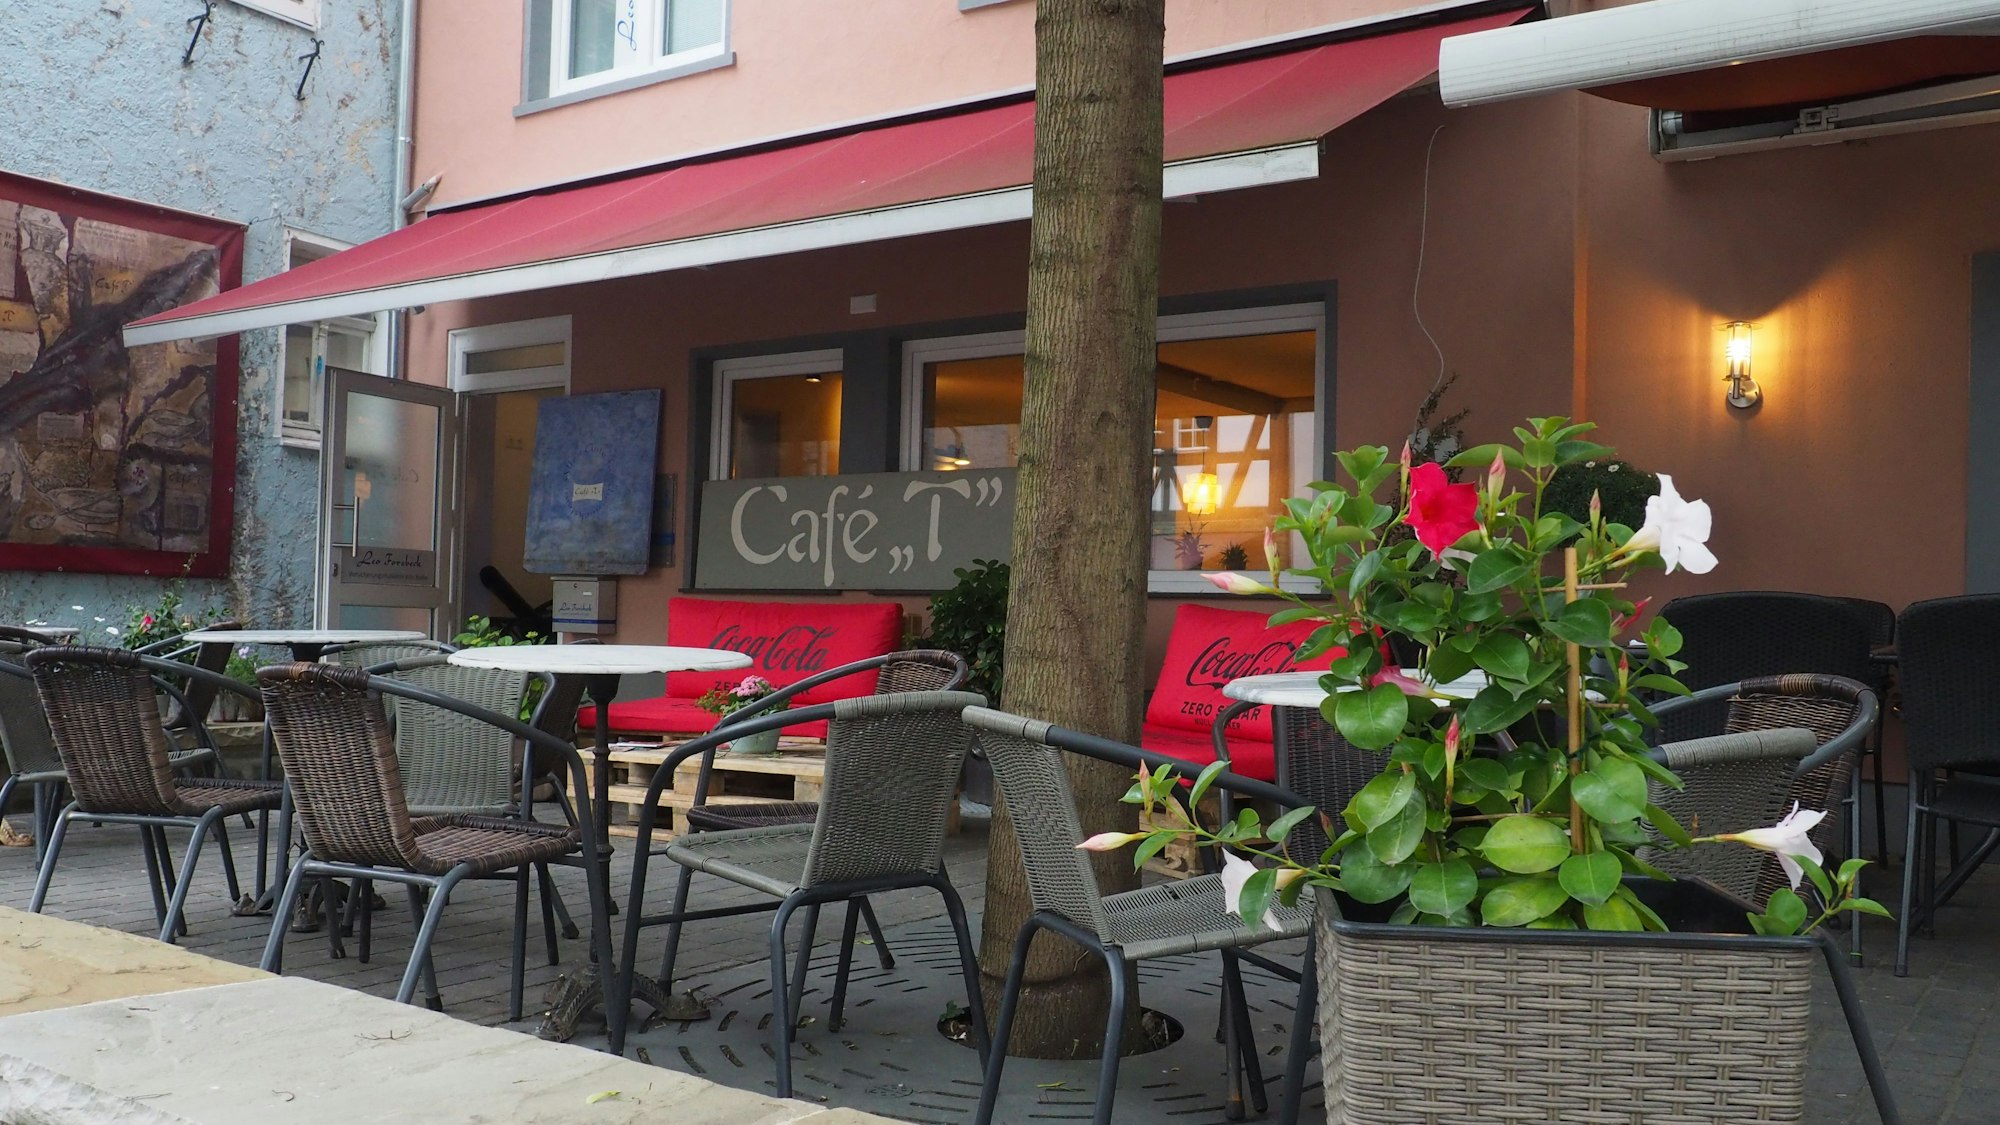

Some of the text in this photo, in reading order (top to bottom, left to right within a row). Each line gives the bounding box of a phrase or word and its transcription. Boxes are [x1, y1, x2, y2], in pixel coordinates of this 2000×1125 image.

[730, 484, 879, 588] Café
[357, 550, 381, 567] Leo
[1181, 701, 1262, 721] ZERO SAR
